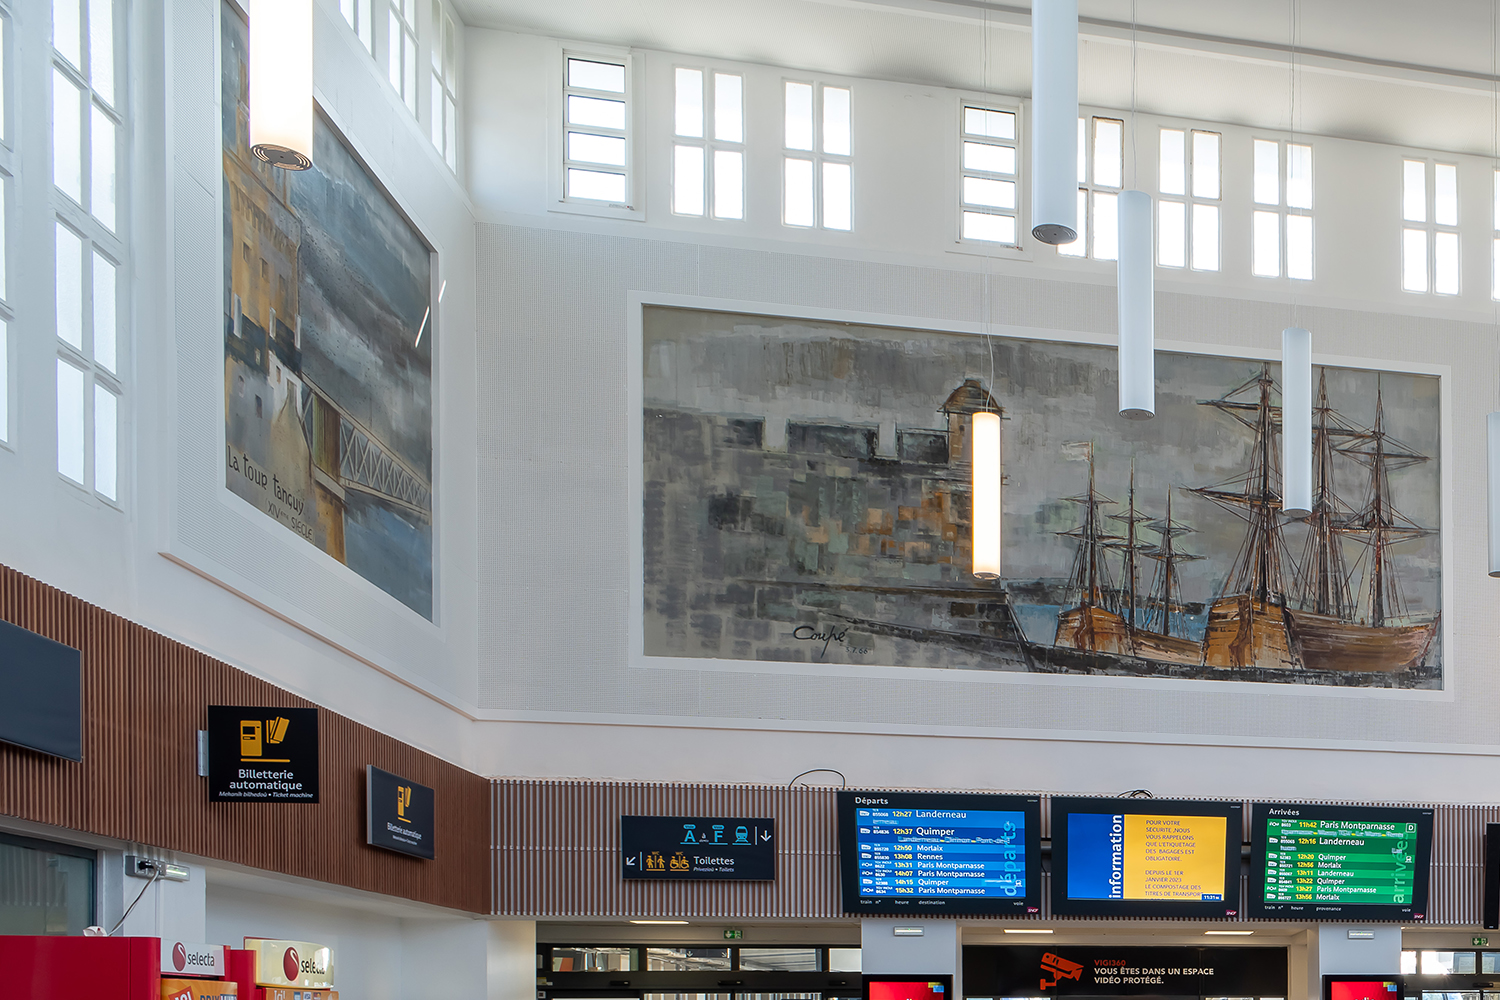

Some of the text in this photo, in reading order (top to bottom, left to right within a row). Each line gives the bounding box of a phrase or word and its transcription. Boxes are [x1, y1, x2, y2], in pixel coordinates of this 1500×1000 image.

[228, 445, 240, 473] La
[238, 769, 293, 779] Billetterie
[229, 780, 302, 792] automatique
[855, 797, 888, 806] Départs
[916, 810, 967, 818] Landerneau
[1269, 808, 1300, 816] Arrivées
[1320, 821, 1339, 829] Paris
[1340, 822, 1395, 831] Montparnasse
[684, 830, 723, 842] A F
[916, 827, 955, 837] Quimper
[1319, 837, 1365, 845] Landerneau
[693, 856, 734, 865] Toilettes
[1000, 820, 1021, 897] départs
[1108, 815, 1122, 899] information
[937, 862, 985, 870] Montparnasse
[937, 871, 985, 879] Montparnasse
[918, 878, 949, 887] Quimper
[938, 887, 985, 895] Montparnasse
[187, 953, 215, 967] selecta
[1120, 966, 1140, 975] ÊTES
[1094, 975, 1164, 984] VIDÉO PROTÉGÉ.
